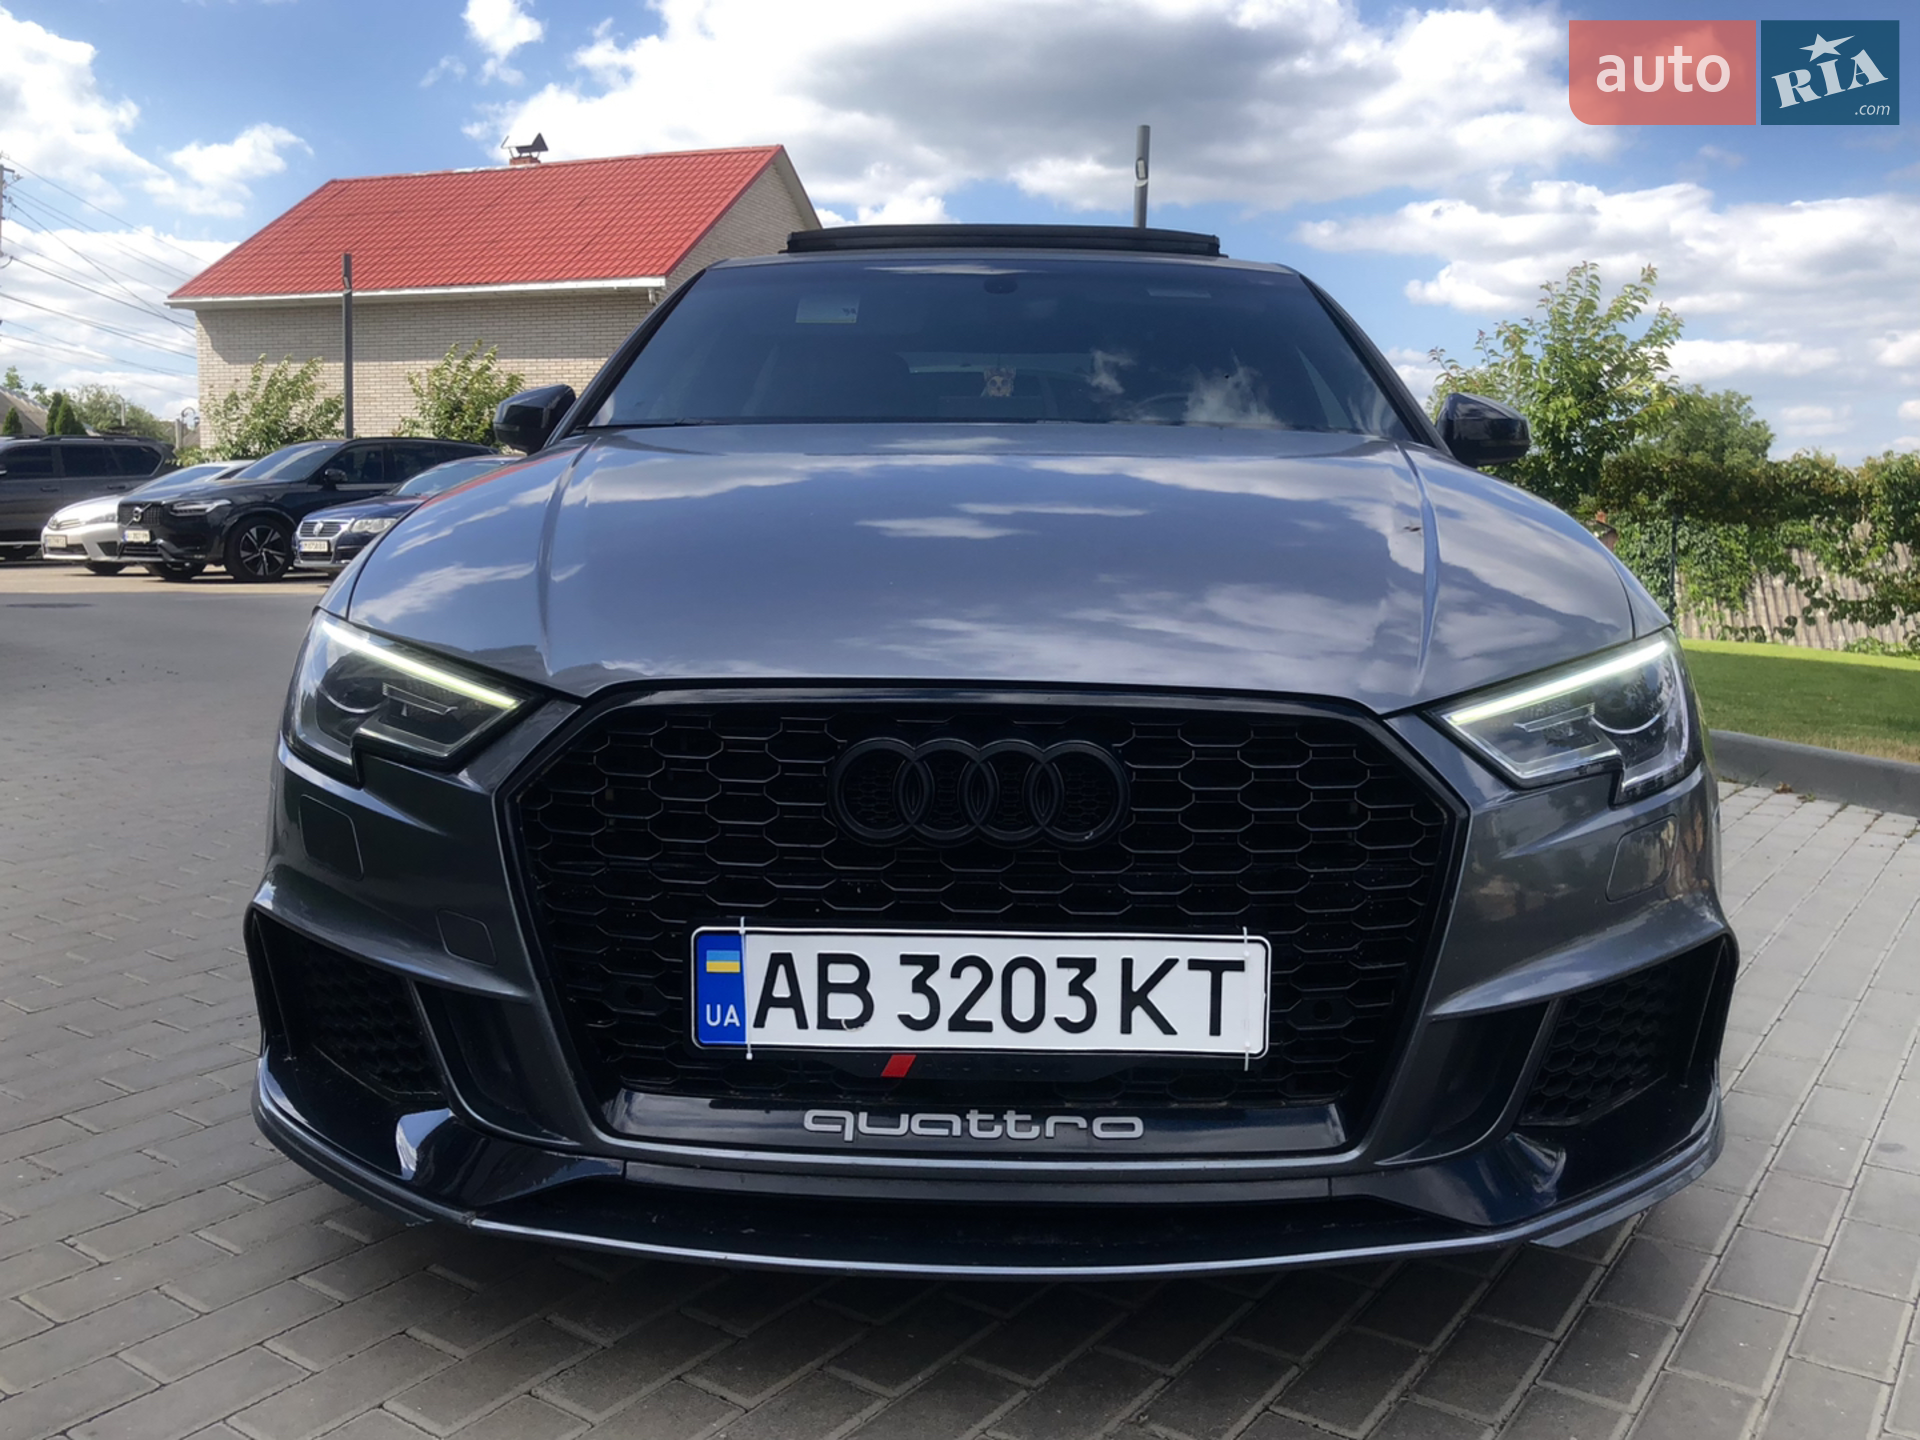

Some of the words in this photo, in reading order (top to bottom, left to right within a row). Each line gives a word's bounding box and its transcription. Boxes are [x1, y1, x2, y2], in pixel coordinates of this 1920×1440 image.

[753, 952, 875, 1031] AB
[897, 954, 1098, 1034] 3203
[1119, 957, 1246, 1036] KT
[706, 1004, 741, 1028] UA
[803, 1108, 1143, 1141] quattro
